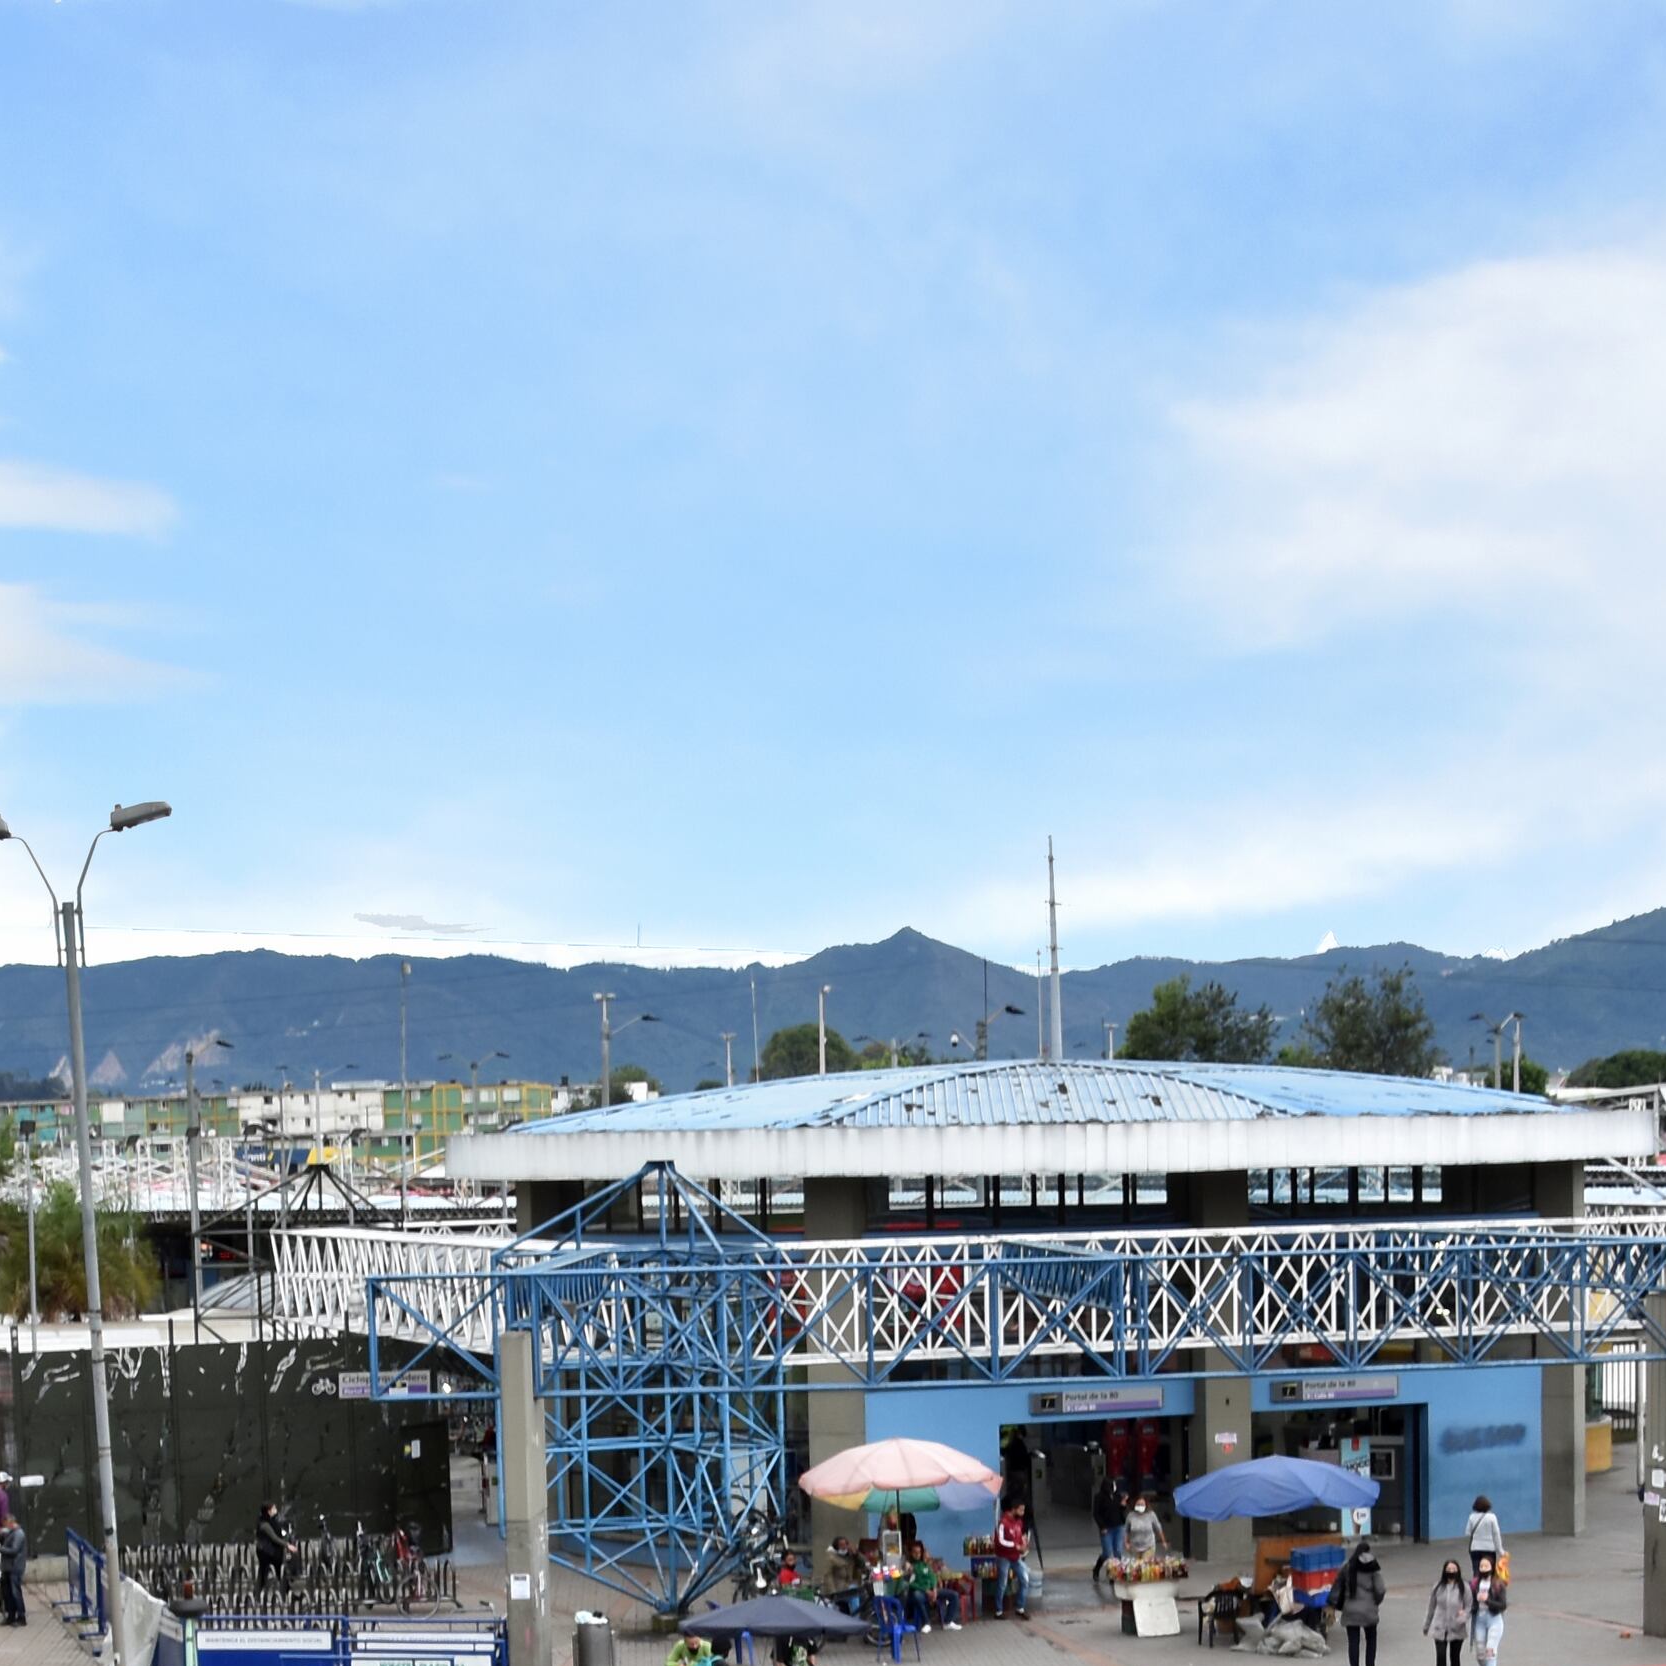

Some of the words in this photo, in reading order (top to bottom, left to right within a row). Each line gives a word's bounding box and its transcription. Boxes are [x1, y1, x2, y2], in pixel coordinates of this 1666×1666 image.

[1065, 1392, 1087, 1401] Portal
[1089, 1391, 1099, 1400] de
[1101, 1391, 1108, 1400] la
